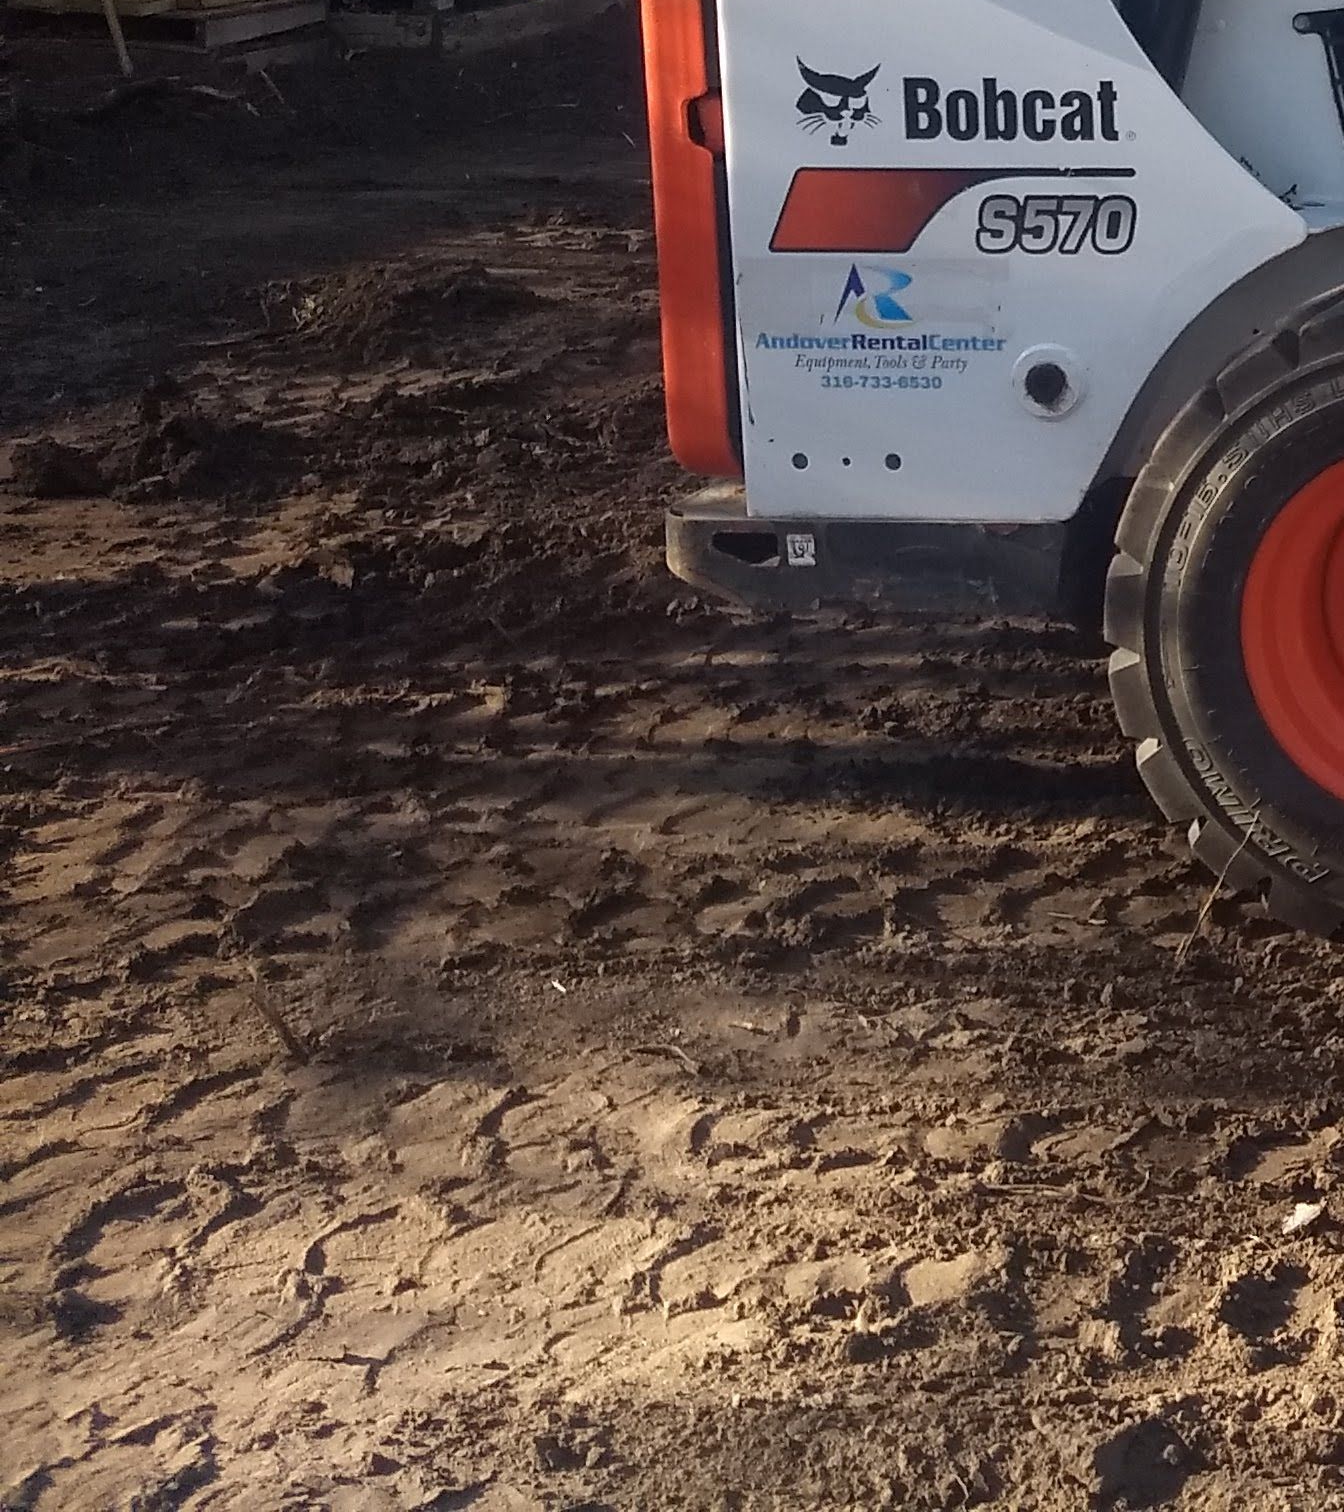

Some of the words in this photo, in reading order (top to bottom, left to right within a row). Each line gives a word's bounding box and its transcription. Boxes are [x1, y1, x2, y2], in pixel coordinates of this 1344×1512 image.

[903, 77, 1120, 141] Bobcat
[975, 194, 1137, 255] S570
[794, 354, 871, 373] Equipment,
[874, 354, 908, 369] Tools
[931, 354, 968, 374] Party
